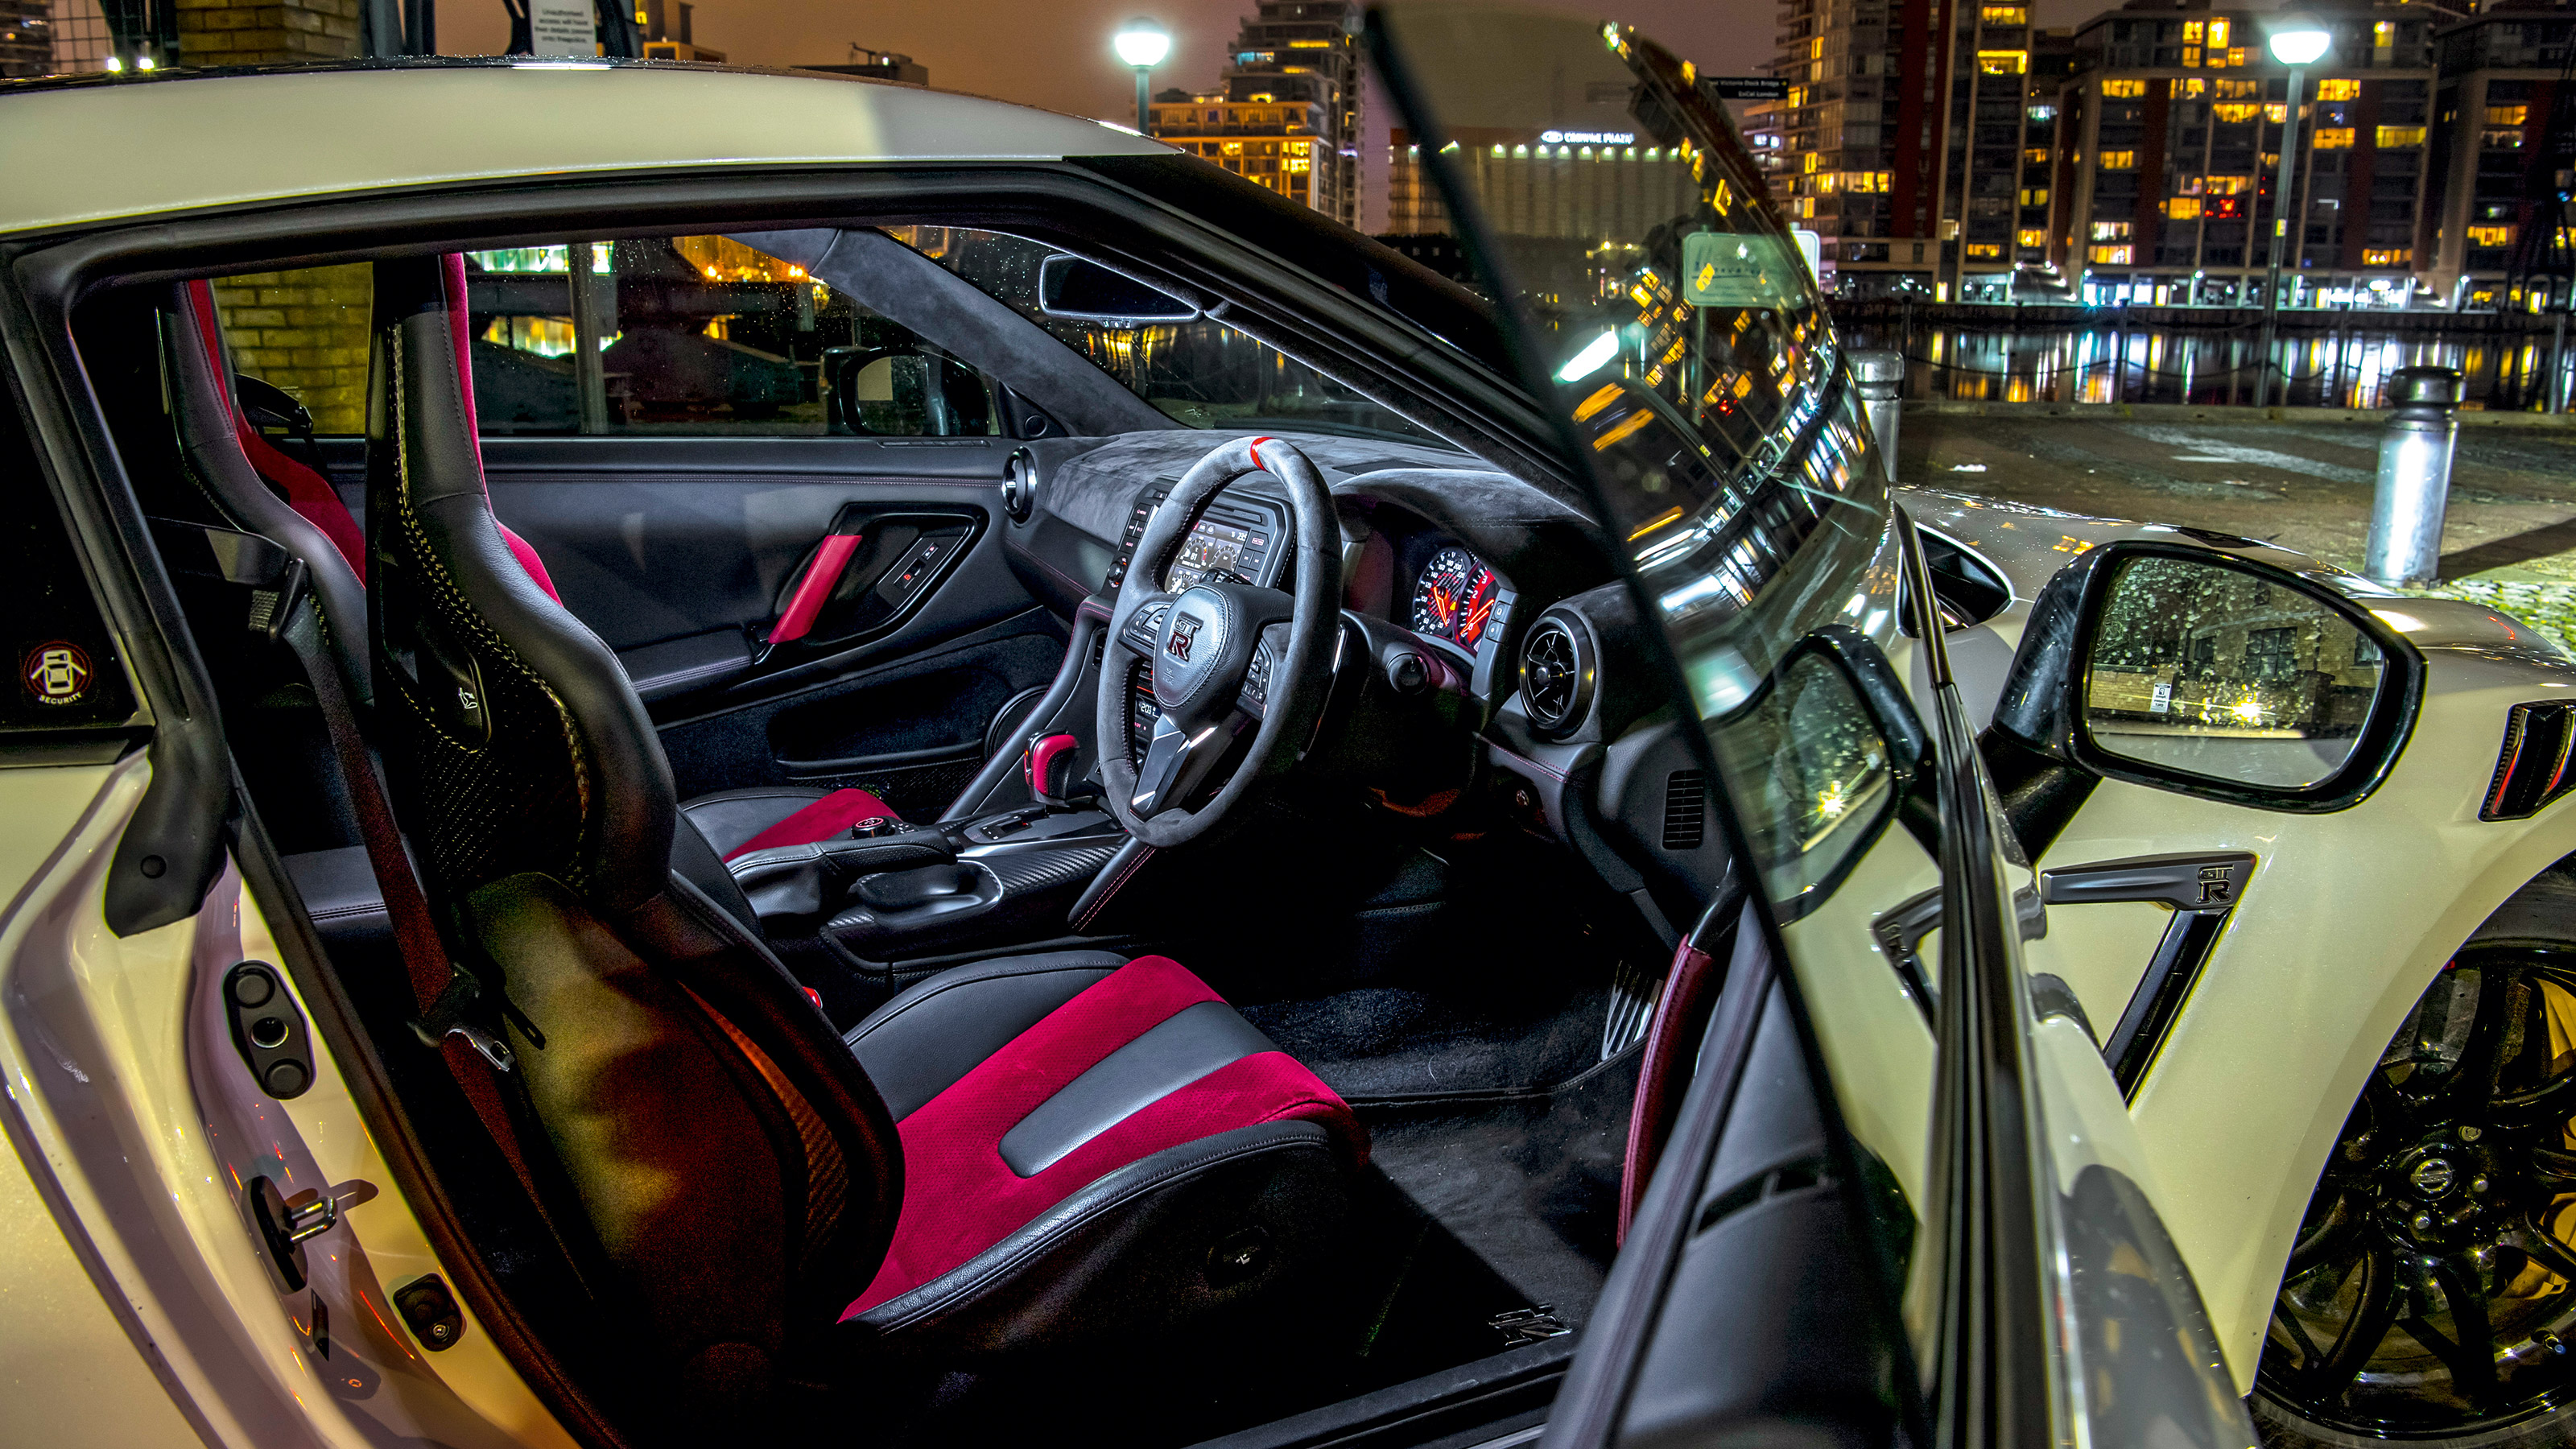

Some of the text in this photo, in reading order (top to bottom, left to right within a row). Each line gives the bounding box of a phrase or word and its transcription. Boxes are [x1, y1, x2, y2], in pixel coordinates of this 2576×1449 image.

[1564, 131, 1633, 145] CROWNE PLAZA
[1481, 575, 1488, 584] 3
[1472, 589, 1479, 599] 2
[1166, 630, 1191, 662] R
[39, 691, 82, 705] SECURITY
[2197, 865, 2235, 881] GT
[2195, 879, 2231, 904] R
